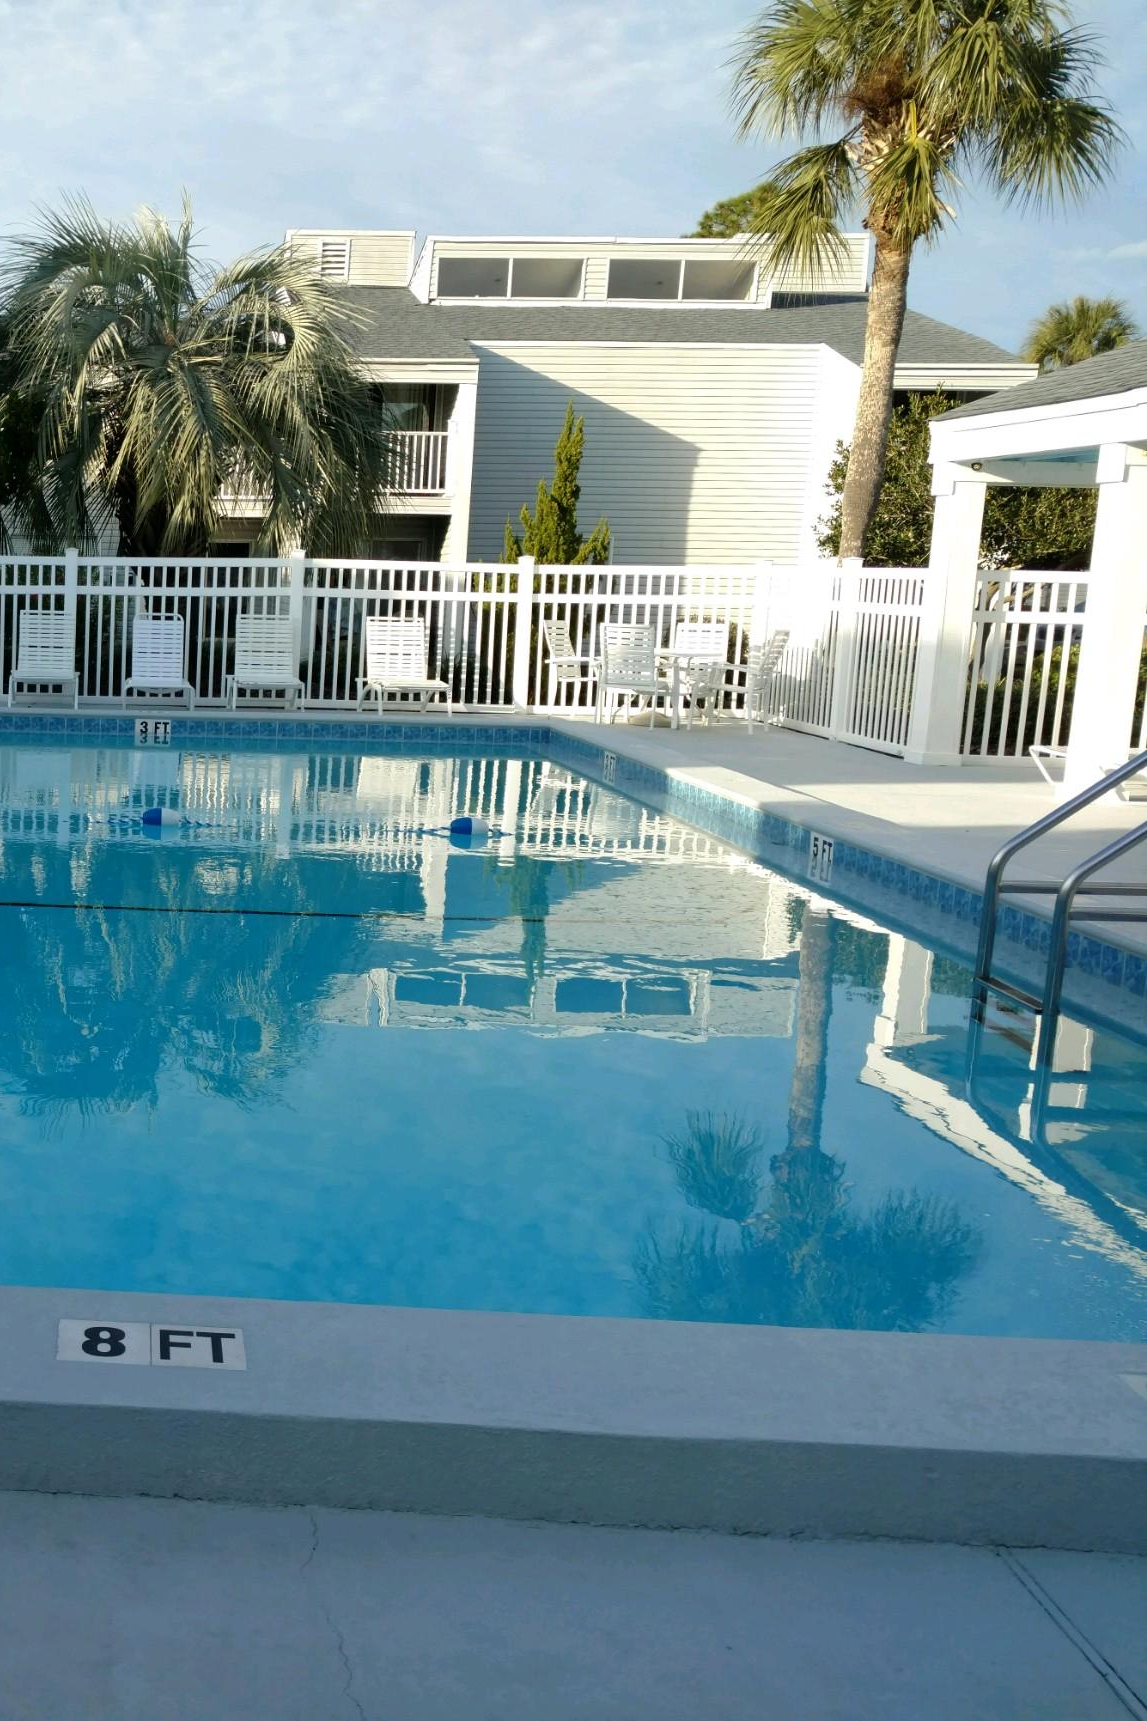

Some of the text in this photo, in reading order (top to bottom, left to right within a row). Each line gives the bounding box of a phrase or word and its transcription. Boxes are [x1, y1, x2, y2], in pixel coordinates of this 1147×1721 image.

[139, 721, 148, 733] 3
[813, 836, 819, 856] 5
[81, 1326, 236, 1364] 8 FT
